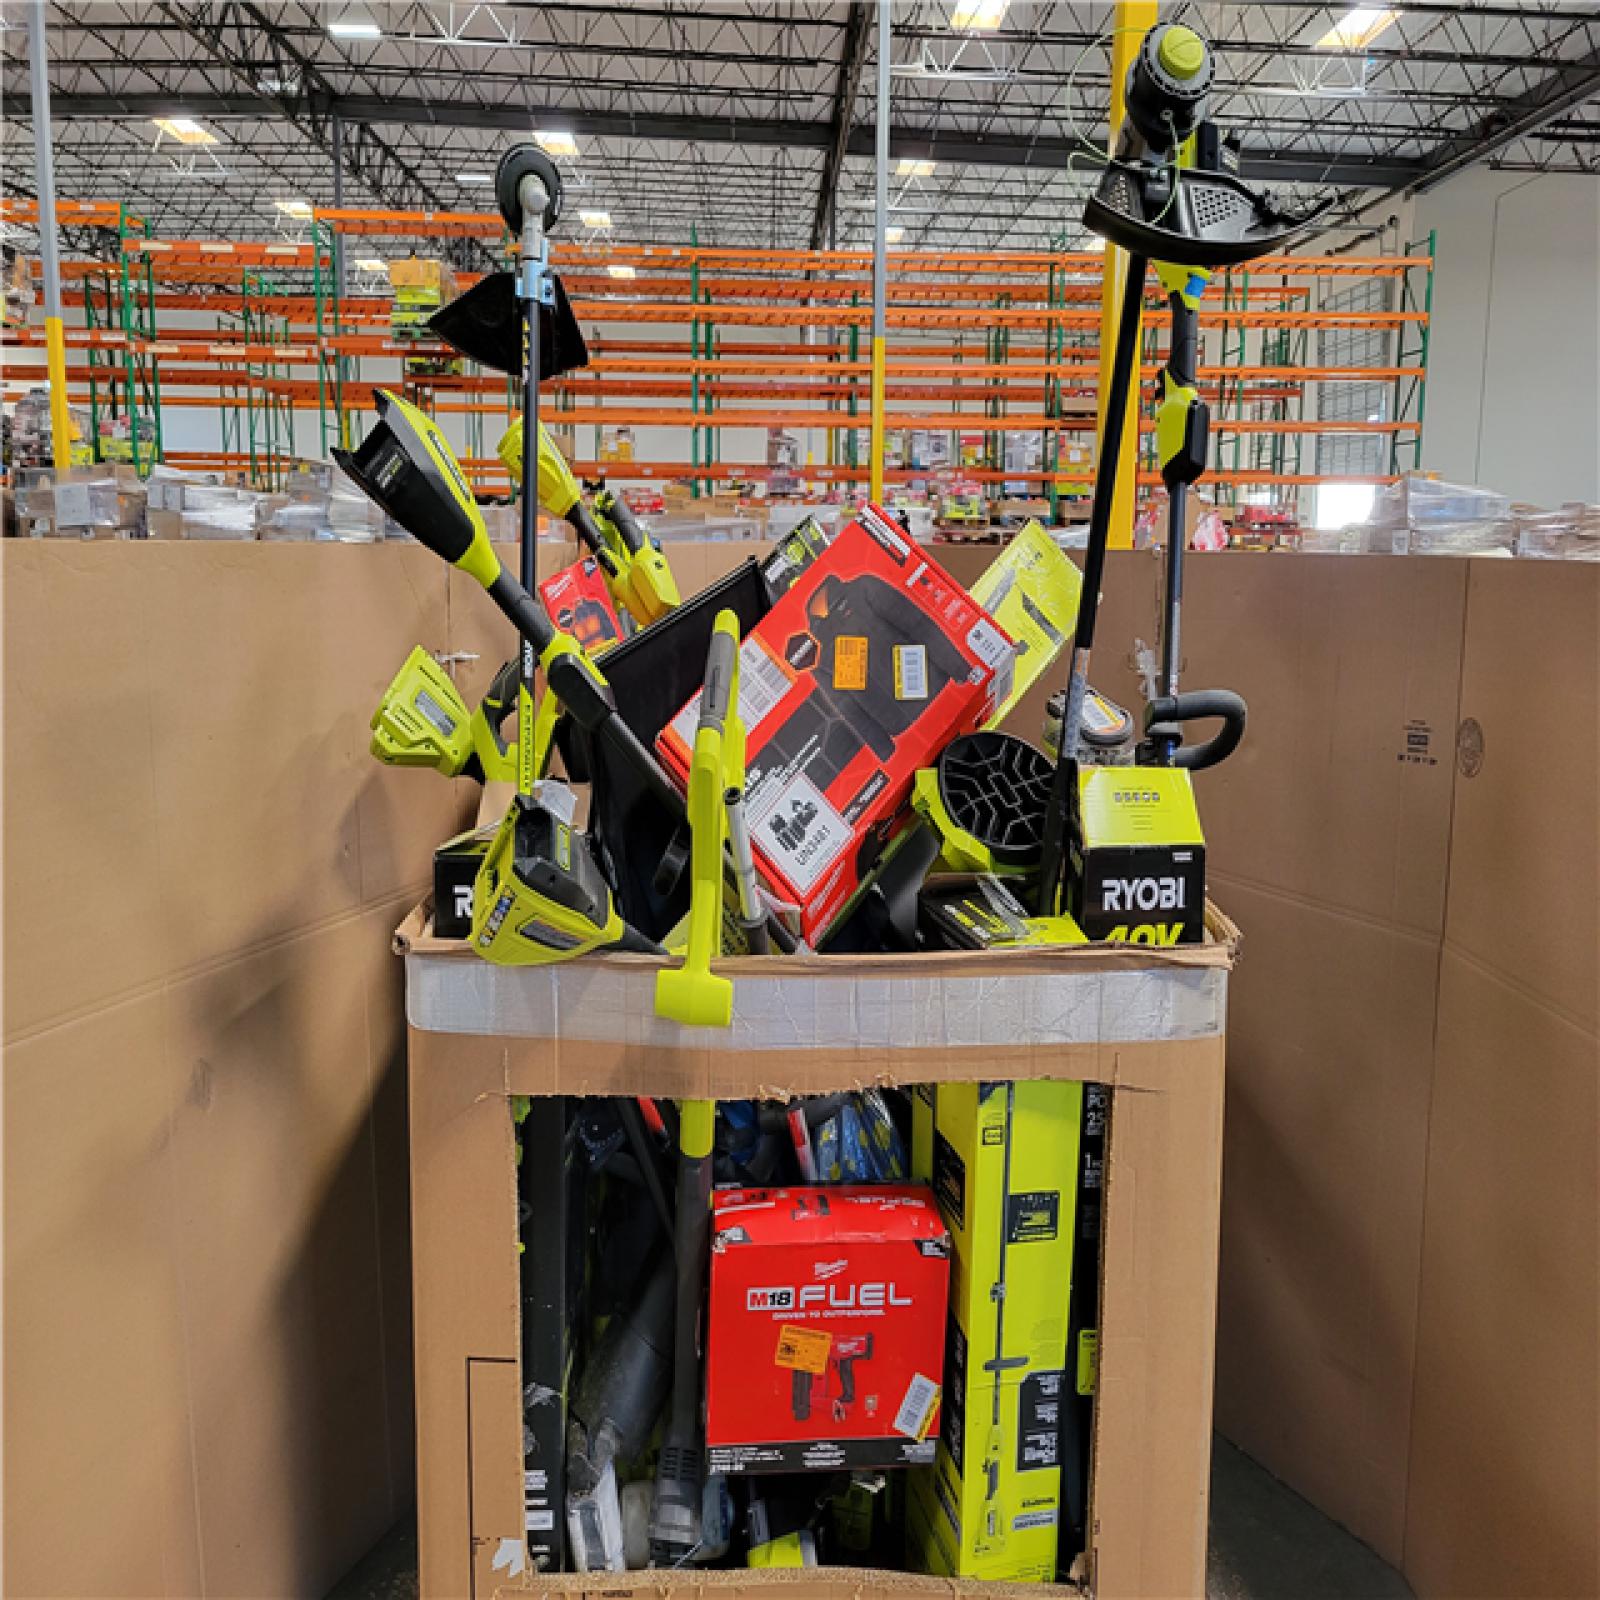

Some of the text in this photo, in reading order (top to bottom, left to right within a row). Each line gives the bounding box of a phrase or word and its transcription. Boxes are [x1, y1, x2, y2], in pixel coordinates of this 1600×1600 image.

[1102, 876, 1186, 911] RYOBI
[749, 1282, 913, 1309] M18 FUEL
